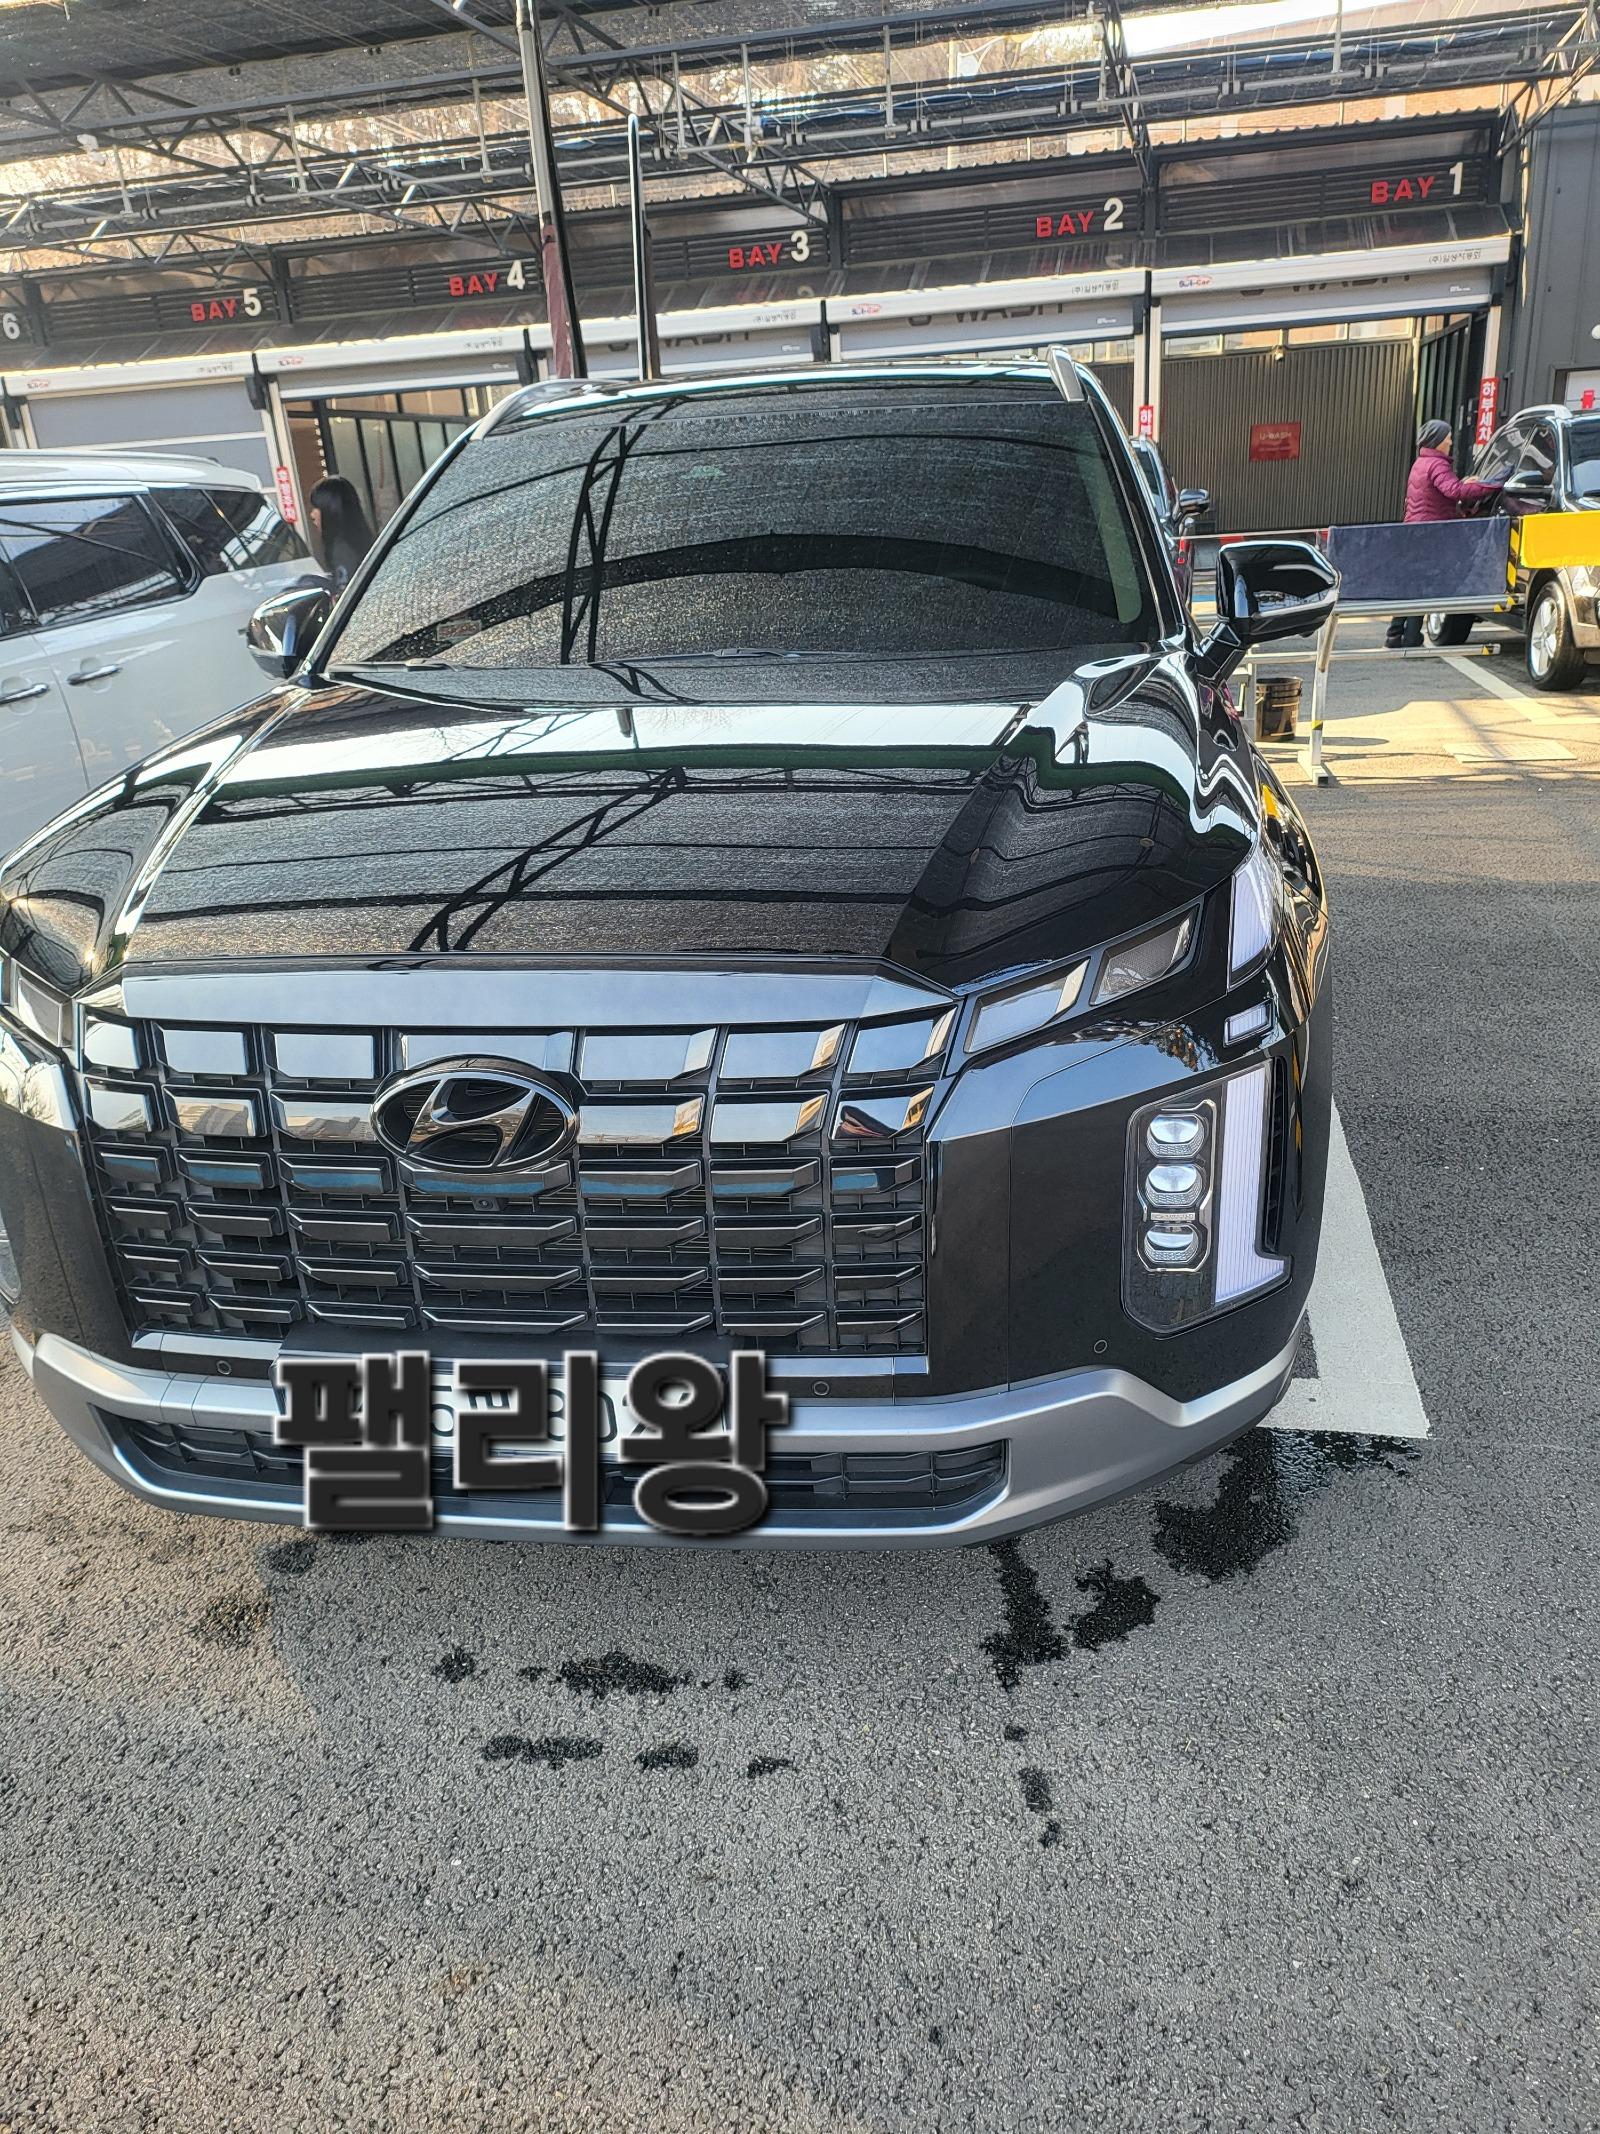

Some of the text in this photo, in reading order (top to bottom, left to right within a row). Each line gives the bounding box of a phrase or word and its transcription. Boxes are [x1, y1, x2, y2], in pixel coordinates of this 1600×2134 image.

[1371, 161, 1463, 204] BAY 1
[1036, 197, 1124, 238] BAY 2
[728, 229, 810, 269] BAY 3
[449, 259, 526, 297] BAY 4
[191, 287, 262, 321] BAY 5
[2, 312, 21, 340] 6
